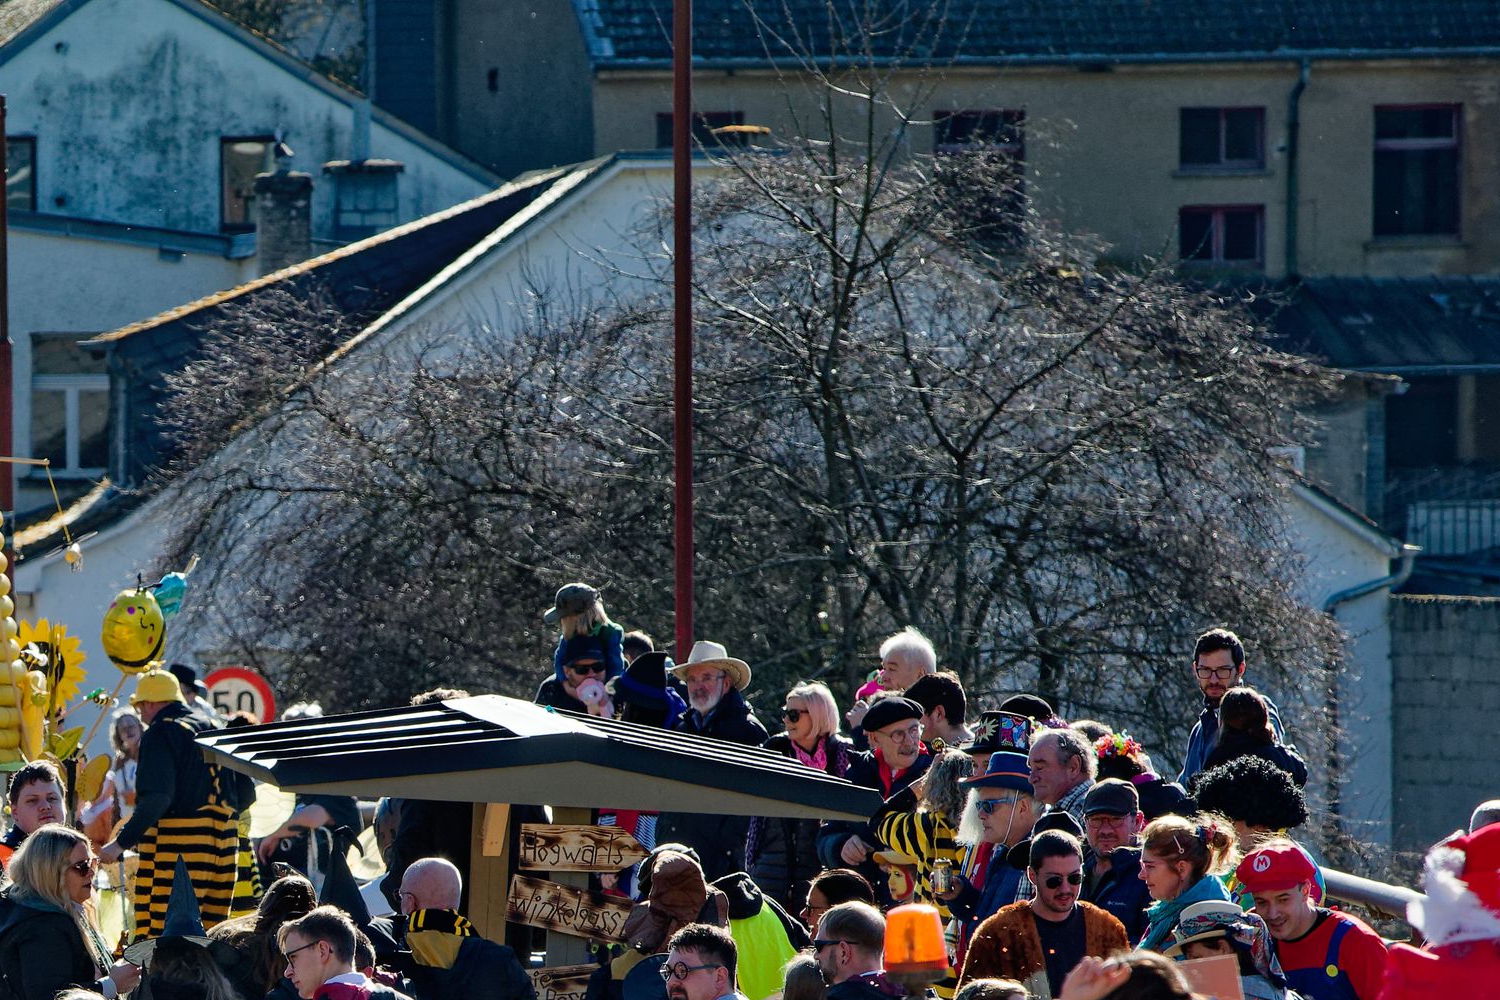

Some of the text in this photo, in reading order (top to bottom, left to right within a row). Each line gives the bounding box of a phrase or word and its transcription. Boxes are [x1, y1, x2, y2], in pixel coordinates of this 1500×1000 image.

[213, 690, 255, 715] 50
[522, 831, 625, 867] Hogwarts
[1256, 856, 1268, 870] M
